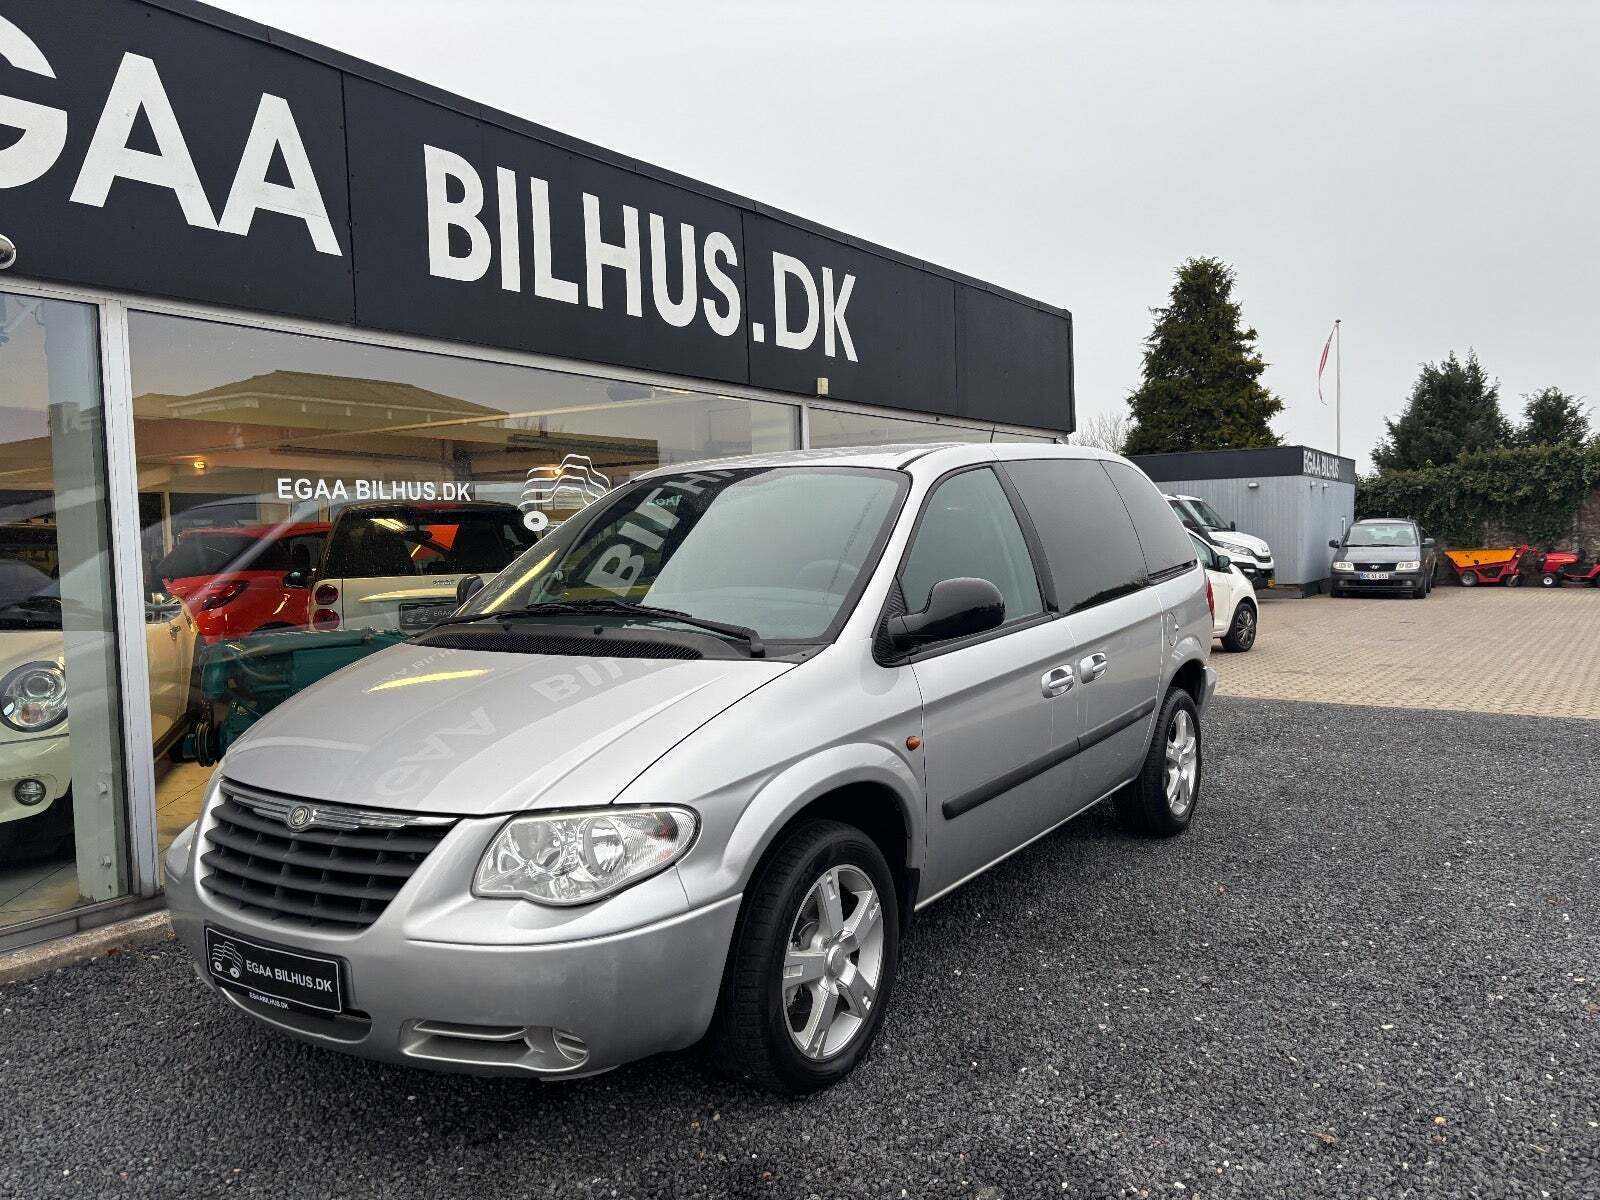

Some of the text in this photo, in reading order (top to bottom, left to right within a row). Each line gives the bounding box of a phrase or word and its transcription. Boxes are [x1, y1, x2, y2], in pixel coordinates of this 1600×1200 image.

[424, 144, 858, 362] BILHUS.DK
[1303, 450, 1320, 475] EGAA
[277, 477, 471, 502] EGAA BILHUS.DK
[245, 959, 333, 993] EGAA BILHUS.DK
